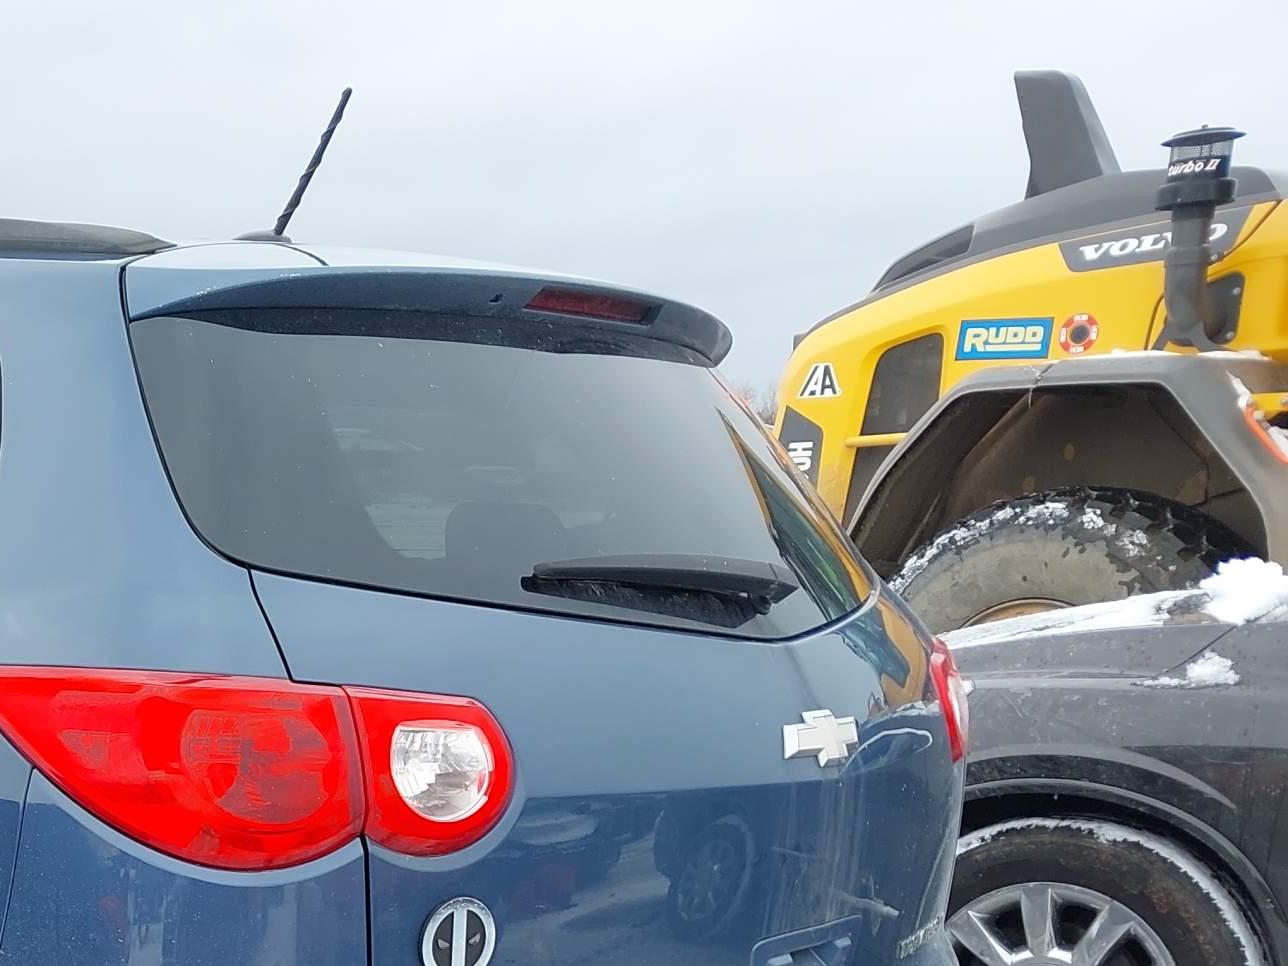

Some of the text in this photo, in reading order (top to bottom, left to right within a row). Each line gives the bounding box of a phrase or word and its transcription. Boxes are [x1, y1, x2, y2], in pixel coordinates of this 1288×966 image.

[1167, 158, 1204, 177] turbo
[1079, 223, 1228, 261] VOLO
[963, 326, 1045, 353] RUDD
